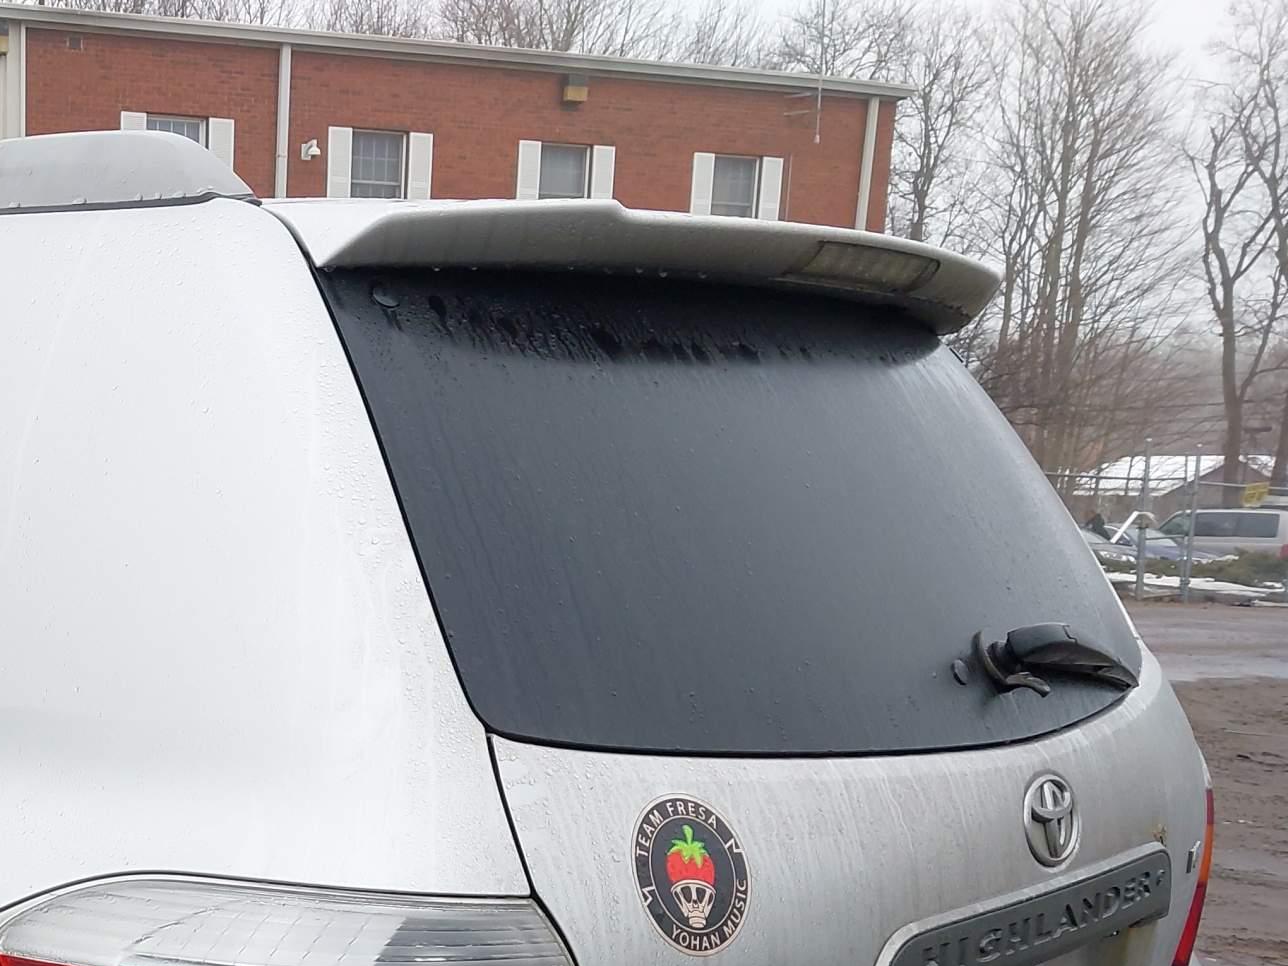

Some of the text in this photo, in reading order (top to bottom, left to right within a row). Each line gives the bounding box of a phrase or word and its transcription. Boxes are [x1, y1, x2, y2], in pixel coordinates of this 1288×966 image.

[636, 801, 718, 857] TEAM FRESA
[671, 879, 748, 951] YOHAN MUSIC
